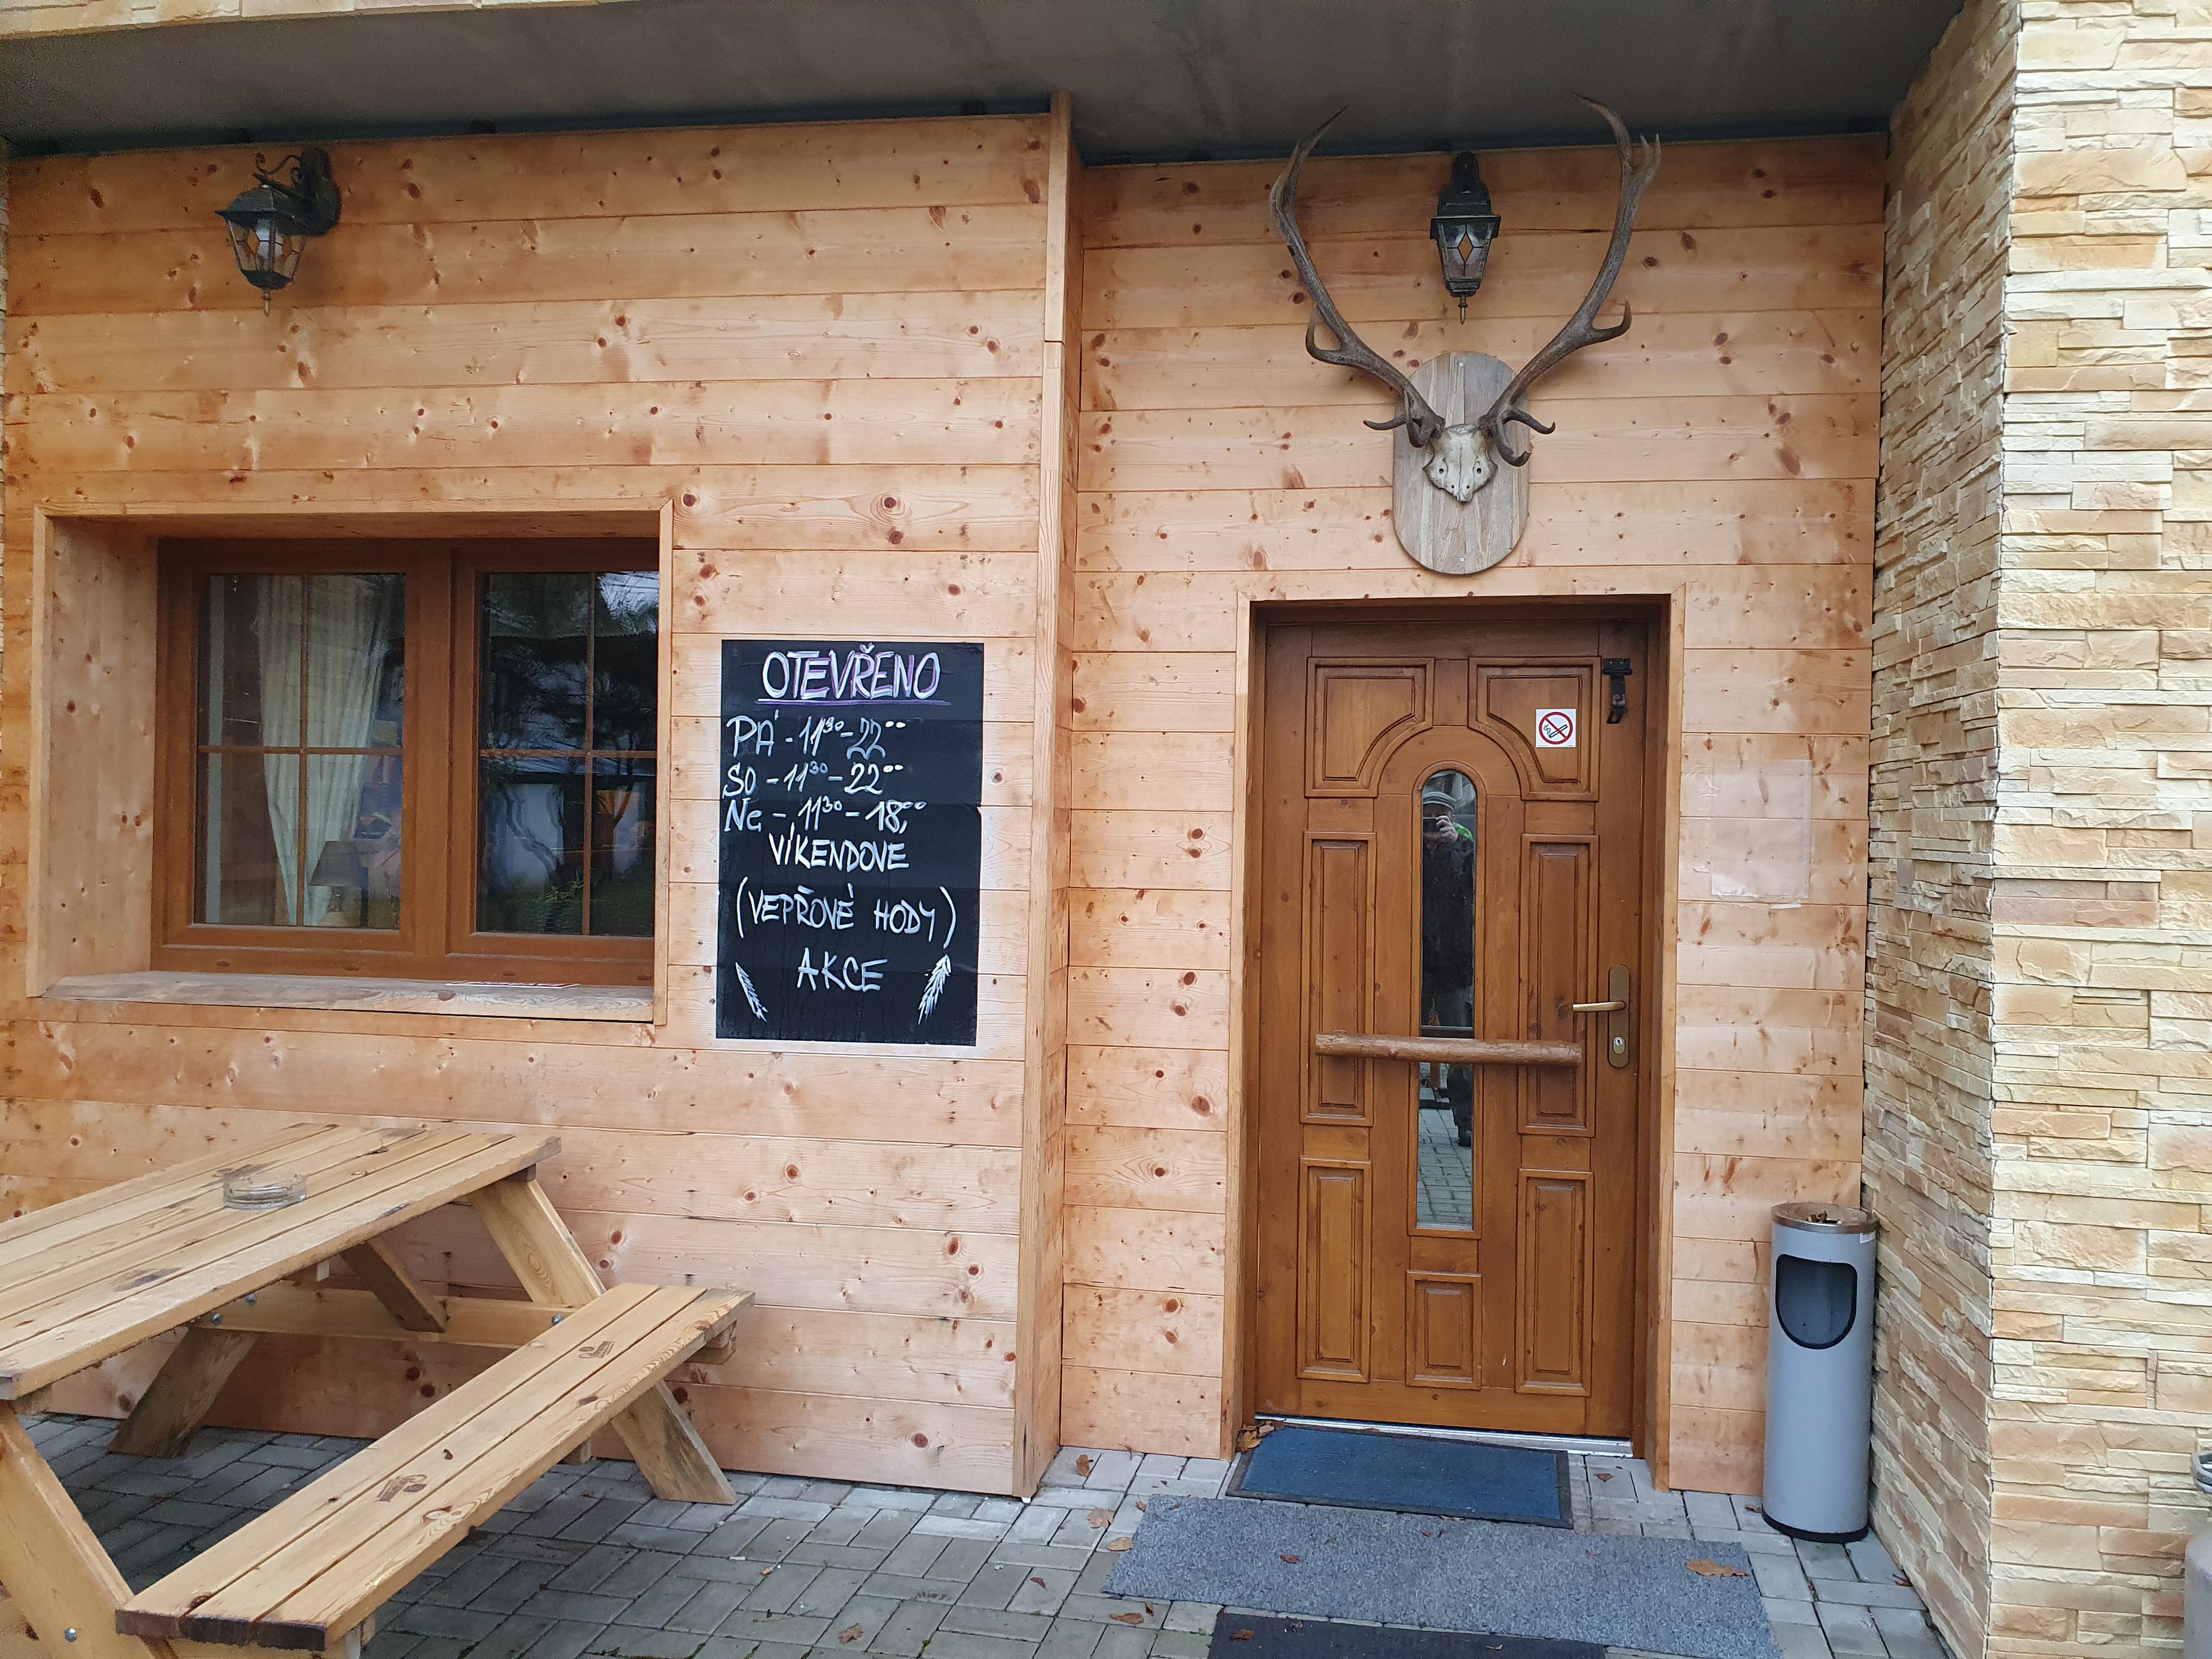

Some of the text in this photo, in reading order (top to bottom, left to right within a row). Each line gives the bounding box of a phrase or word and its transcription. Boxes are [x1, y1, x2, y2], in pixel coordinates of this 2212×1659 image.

[762, 643, 941, 700] OTEVŘENO
[726, 709, 779, 757] PÁ
[722, 762, 757, 799] SO
[797, 946, 888, 992] AKCE
